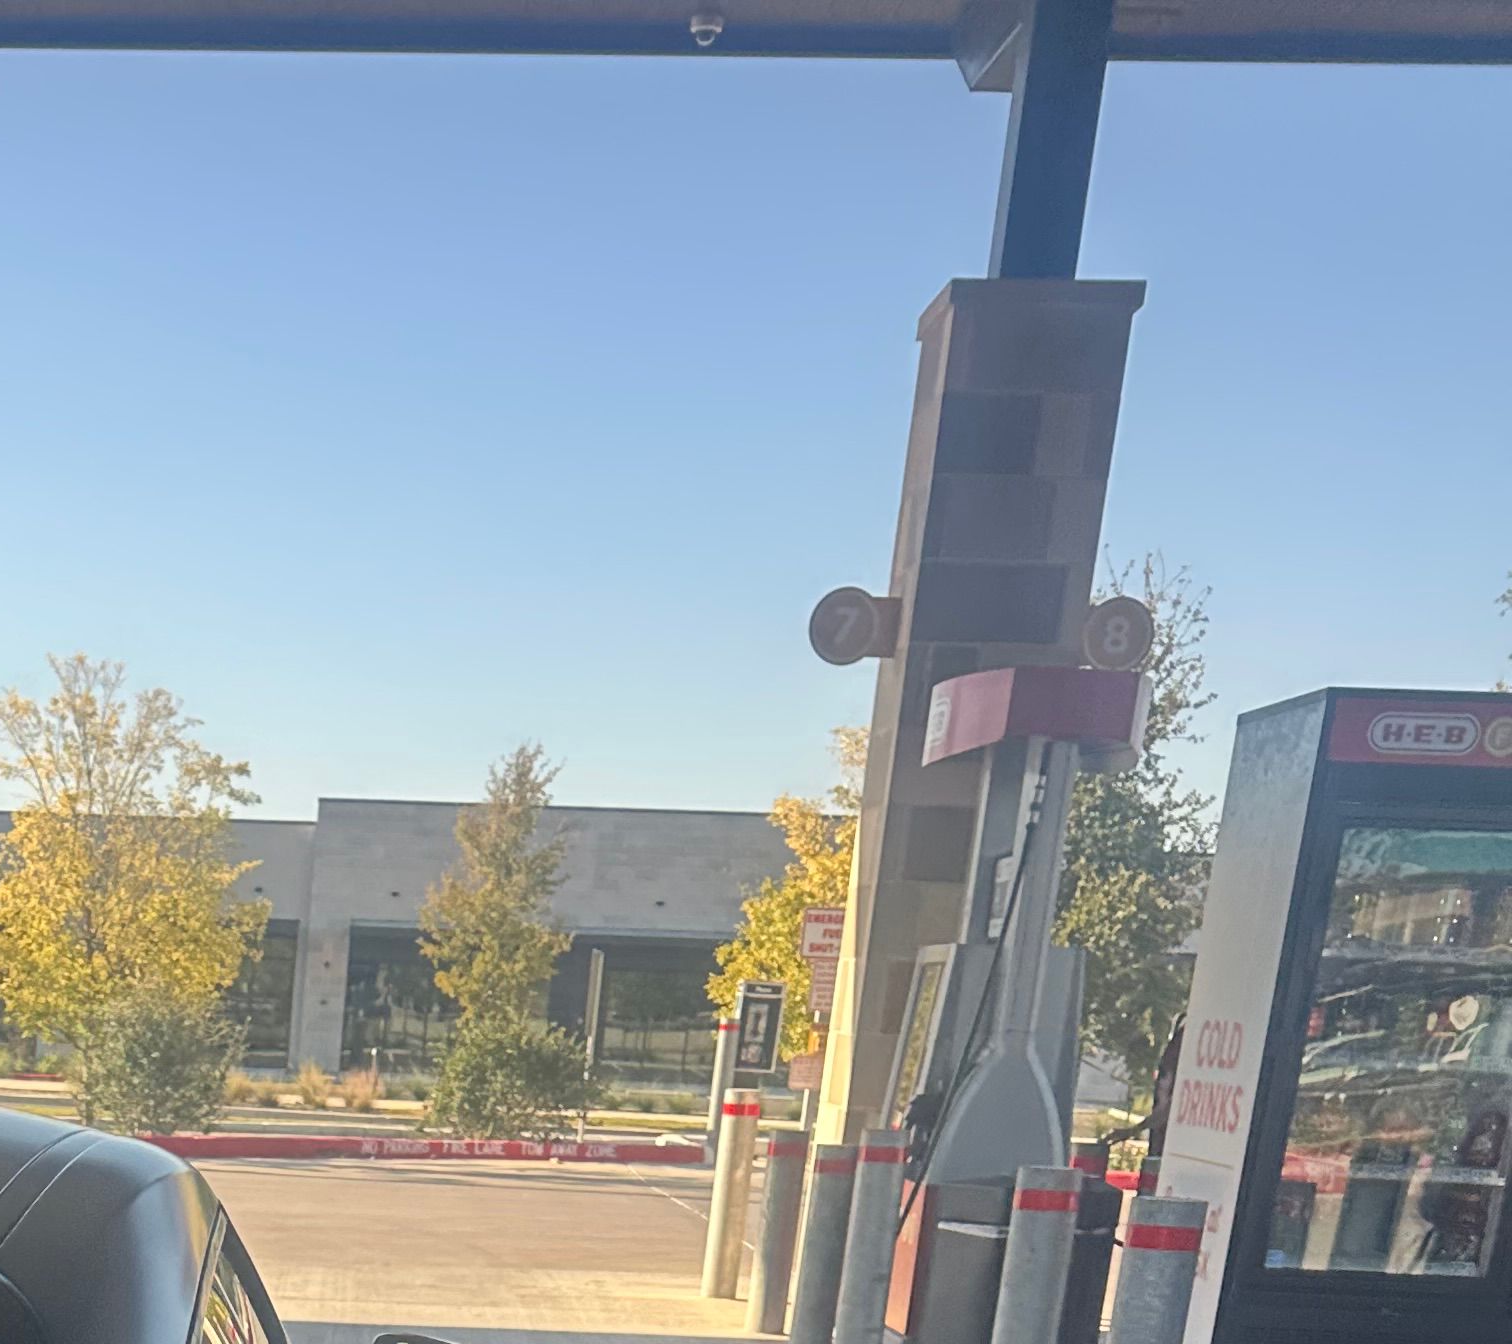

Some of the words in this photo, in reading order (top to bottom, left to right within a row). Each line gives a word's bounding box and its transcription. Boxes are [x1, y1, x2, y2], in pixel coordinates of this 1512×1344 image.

[832, 606, 859, 643] 7
[1102, 614, 1129, 651] 8
[807, 914, 844, 924] EMERG
[822, 929, 841, 939] FUE
[809, 943, 840, 953] SHUT-
[1196, 1020, 1243, 1070] COLD
[1176, 1079, 1243, 1133] DRINKS
[361, 1140, 378, 1154] NO
